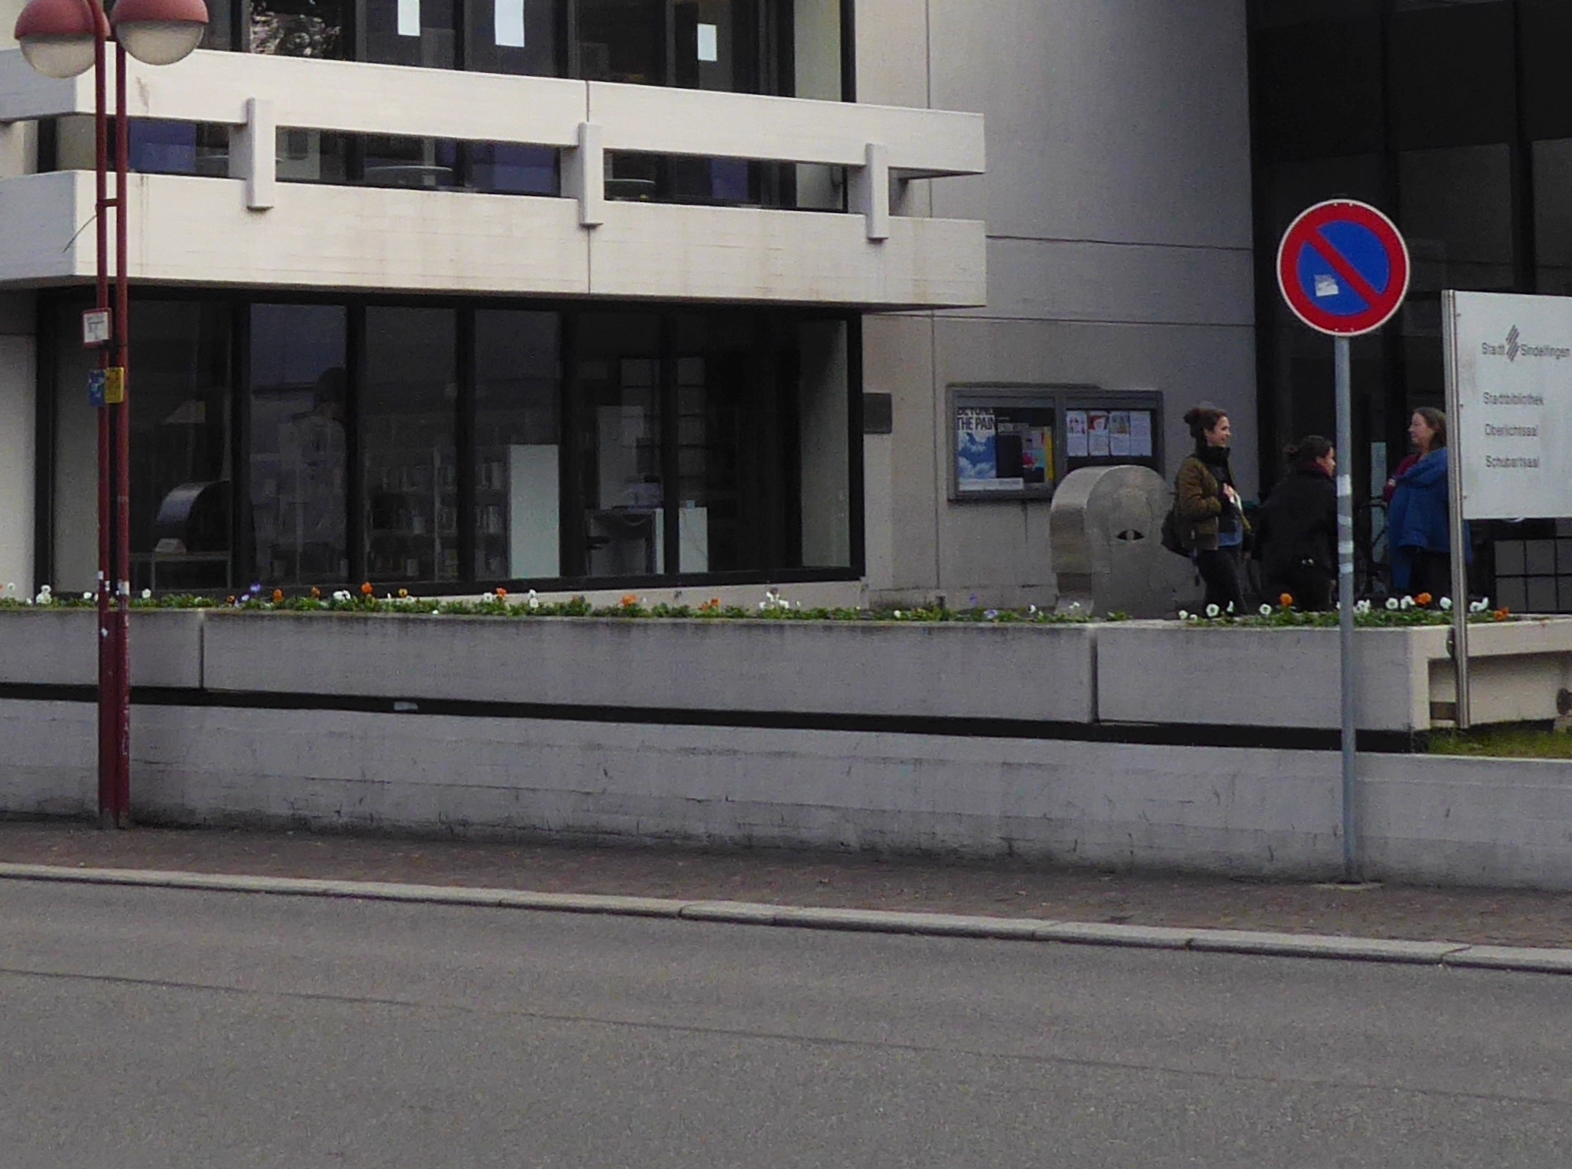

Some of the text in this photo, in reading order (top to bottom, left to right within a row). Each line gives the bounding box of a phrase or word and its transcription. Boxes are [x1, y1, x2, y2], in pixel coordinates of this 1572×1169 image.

[1481, 341, 1571, 360] Stadt Sindelfingen
[1483, 391, 1545, 406] Stadtbibliothek
[957, 416, 974, 430] THE
[1484, 423, 1538, 437] Oberlichtsaal
[1485, 454, 1540, 469] Schubartsaal
